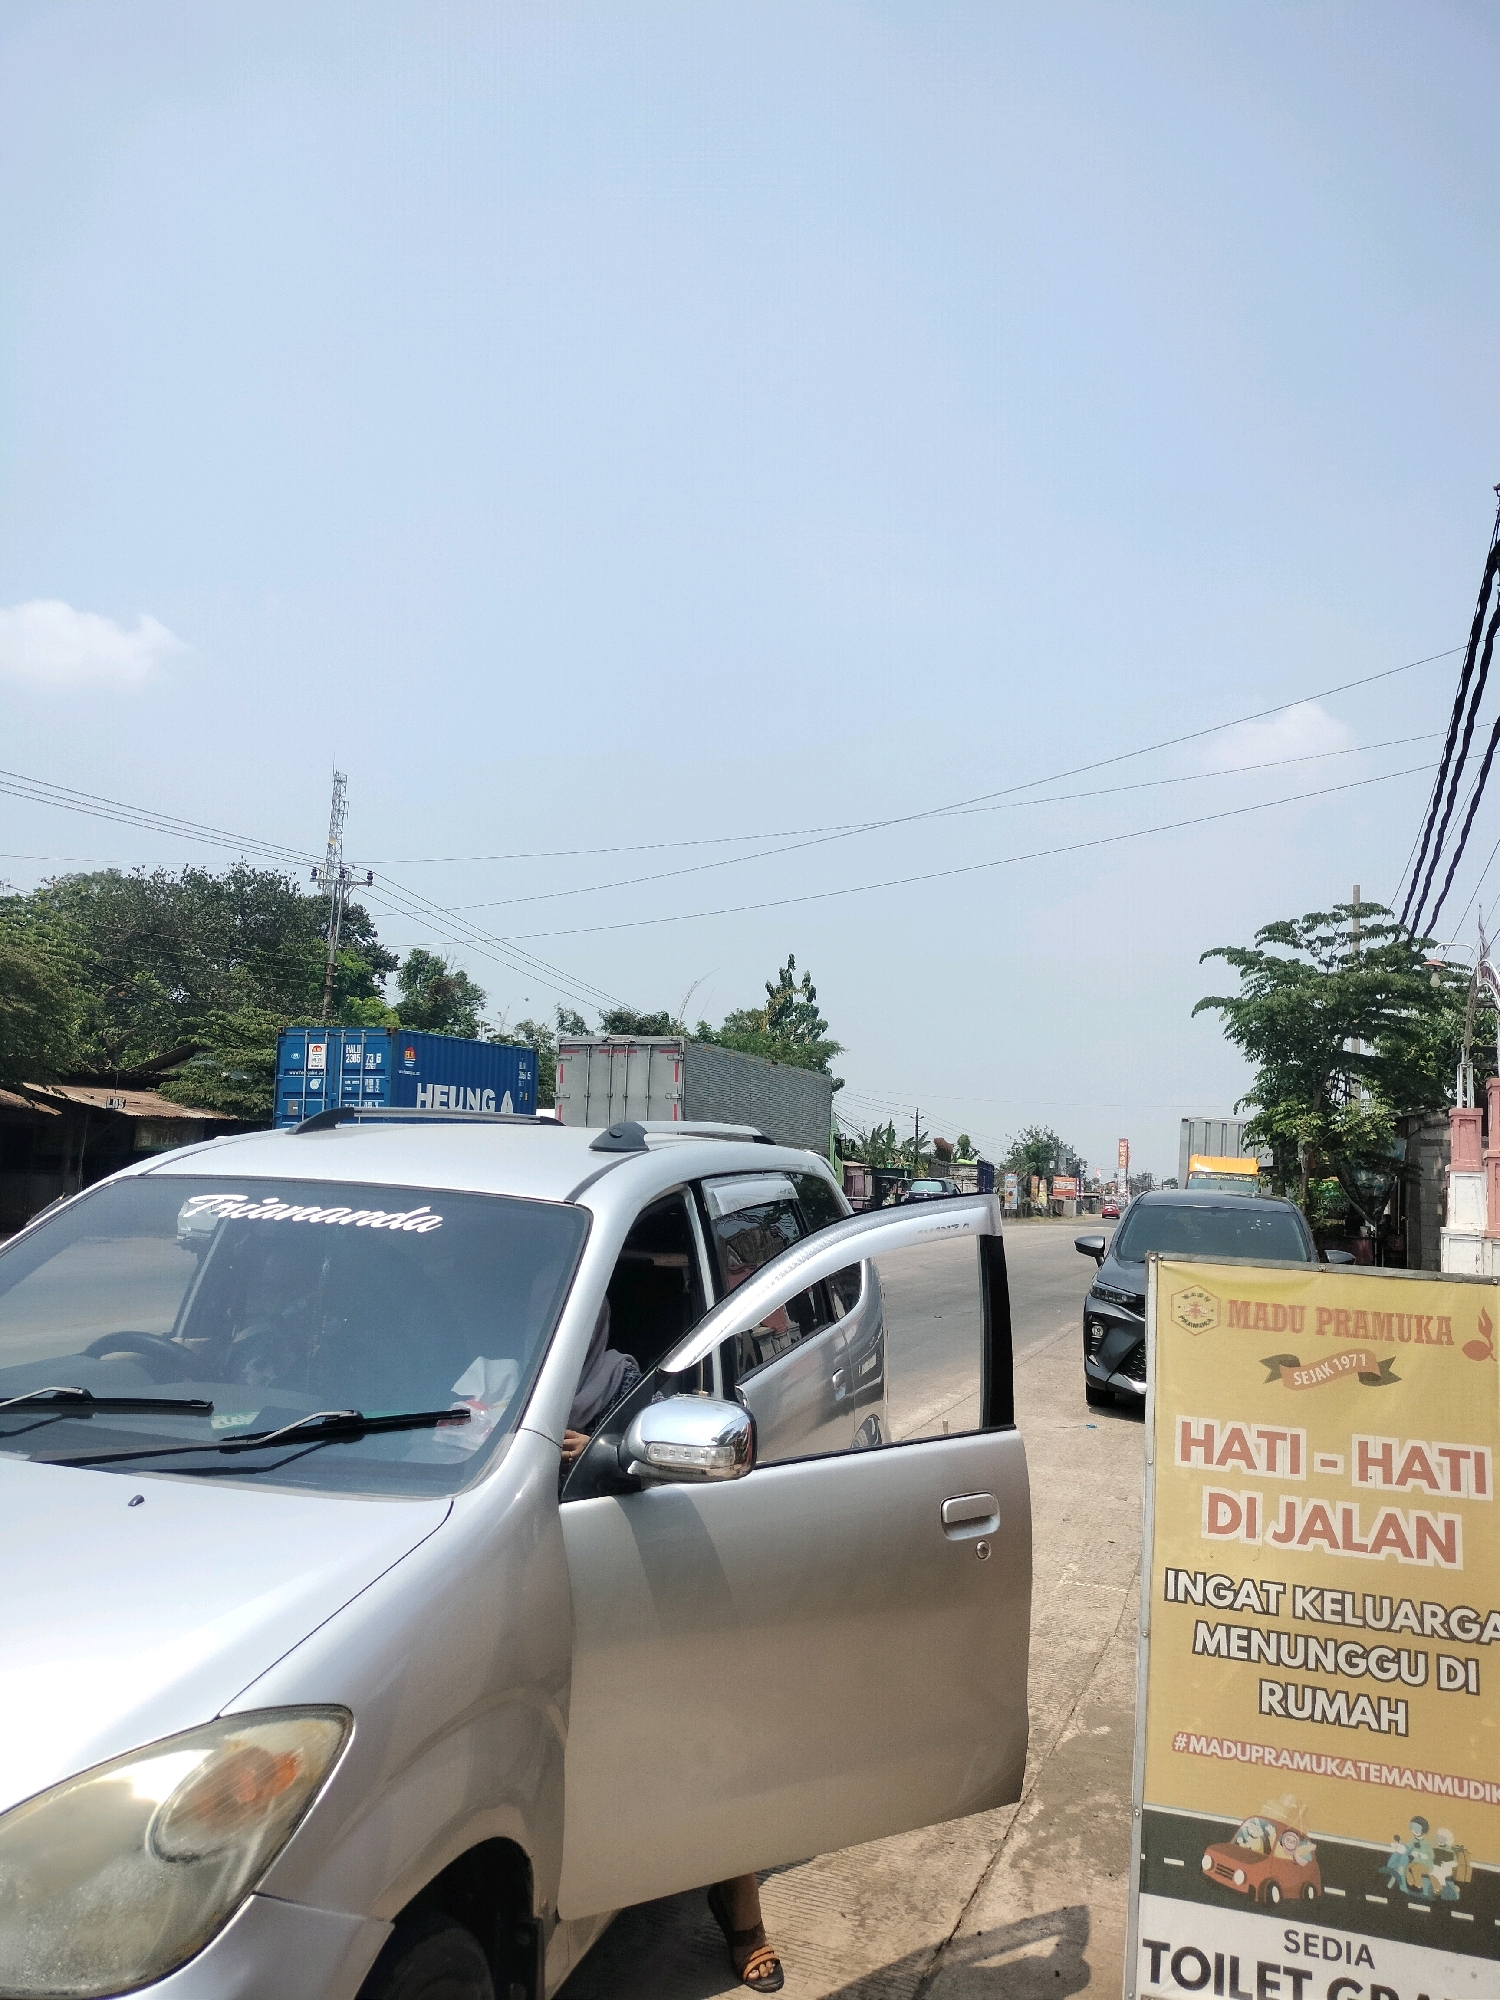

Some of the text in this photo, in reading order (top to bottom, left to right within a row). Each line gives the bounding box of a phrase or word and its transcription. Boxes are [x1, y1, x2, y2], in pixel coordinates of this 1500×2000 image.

[416, 1082, 497, 1113] HEUNG
[1227, 1300, 1455, 1346] MADU PRAMUKA
[1293, 1353, 1367, 1387] SEJAK 1971
[1176, 1416, 1305, 1479] HATI
[1354, 1435, 1492, 1499] HATI
[1203, 1487, 1462, 1568] DI JALAN
[1164, 1568, 1500, 1645] INGAT KELUARGA
[1192, 1620, 1480, 1695] MENUNGGU DI
[1259, 1678, 1409, 1737] RUMAH
[1142, 1938, 1313, 2000] TOILET
[1284, 1929, 1376, 1970] SEDIA
